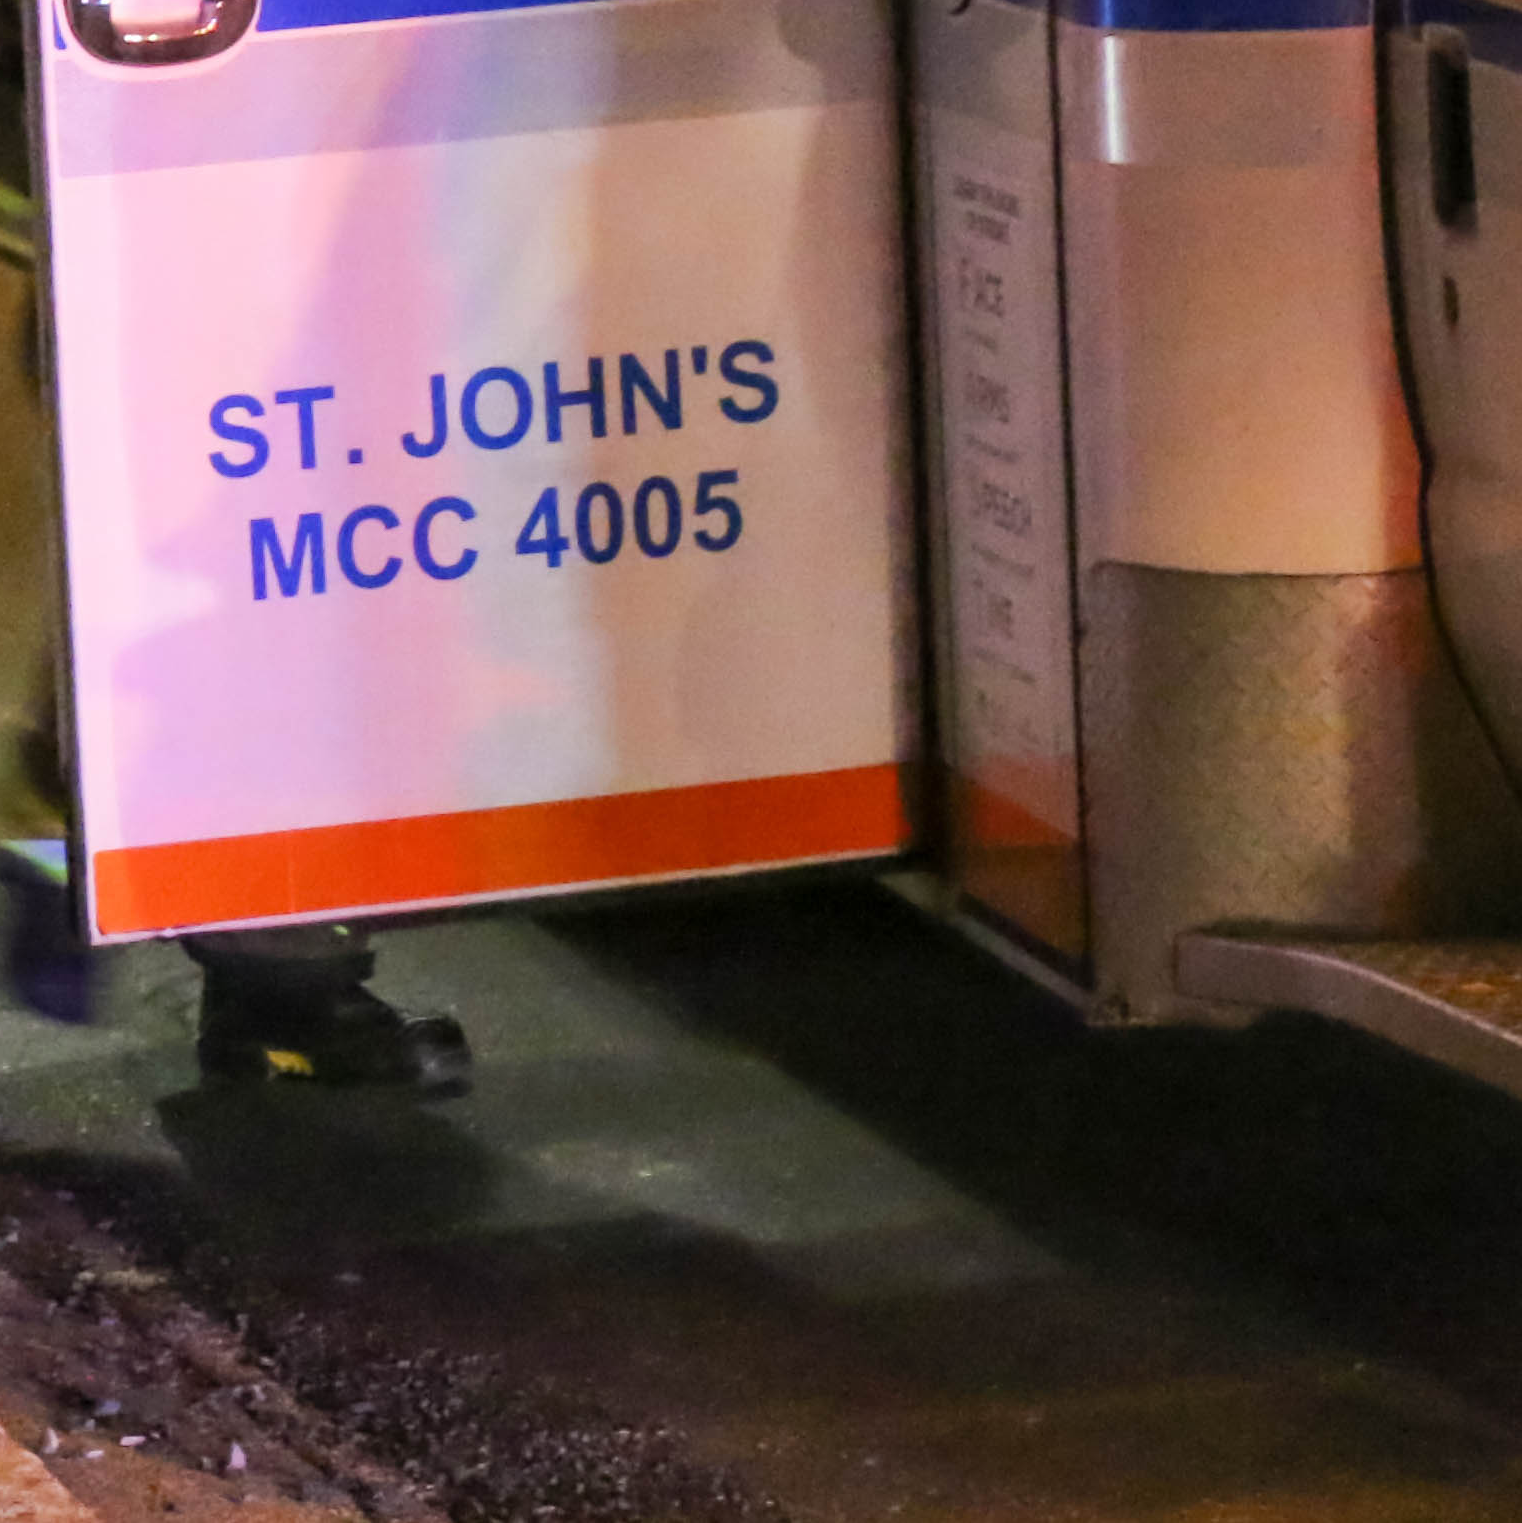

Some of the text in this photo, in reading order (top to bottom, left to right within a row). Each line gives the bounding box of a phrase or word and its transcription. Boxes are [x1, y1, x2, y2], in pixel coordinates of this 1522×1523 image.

[207, 339, 781, 479] ST. JOHN'S
[249, 469, 744, 601] MCC 4005
